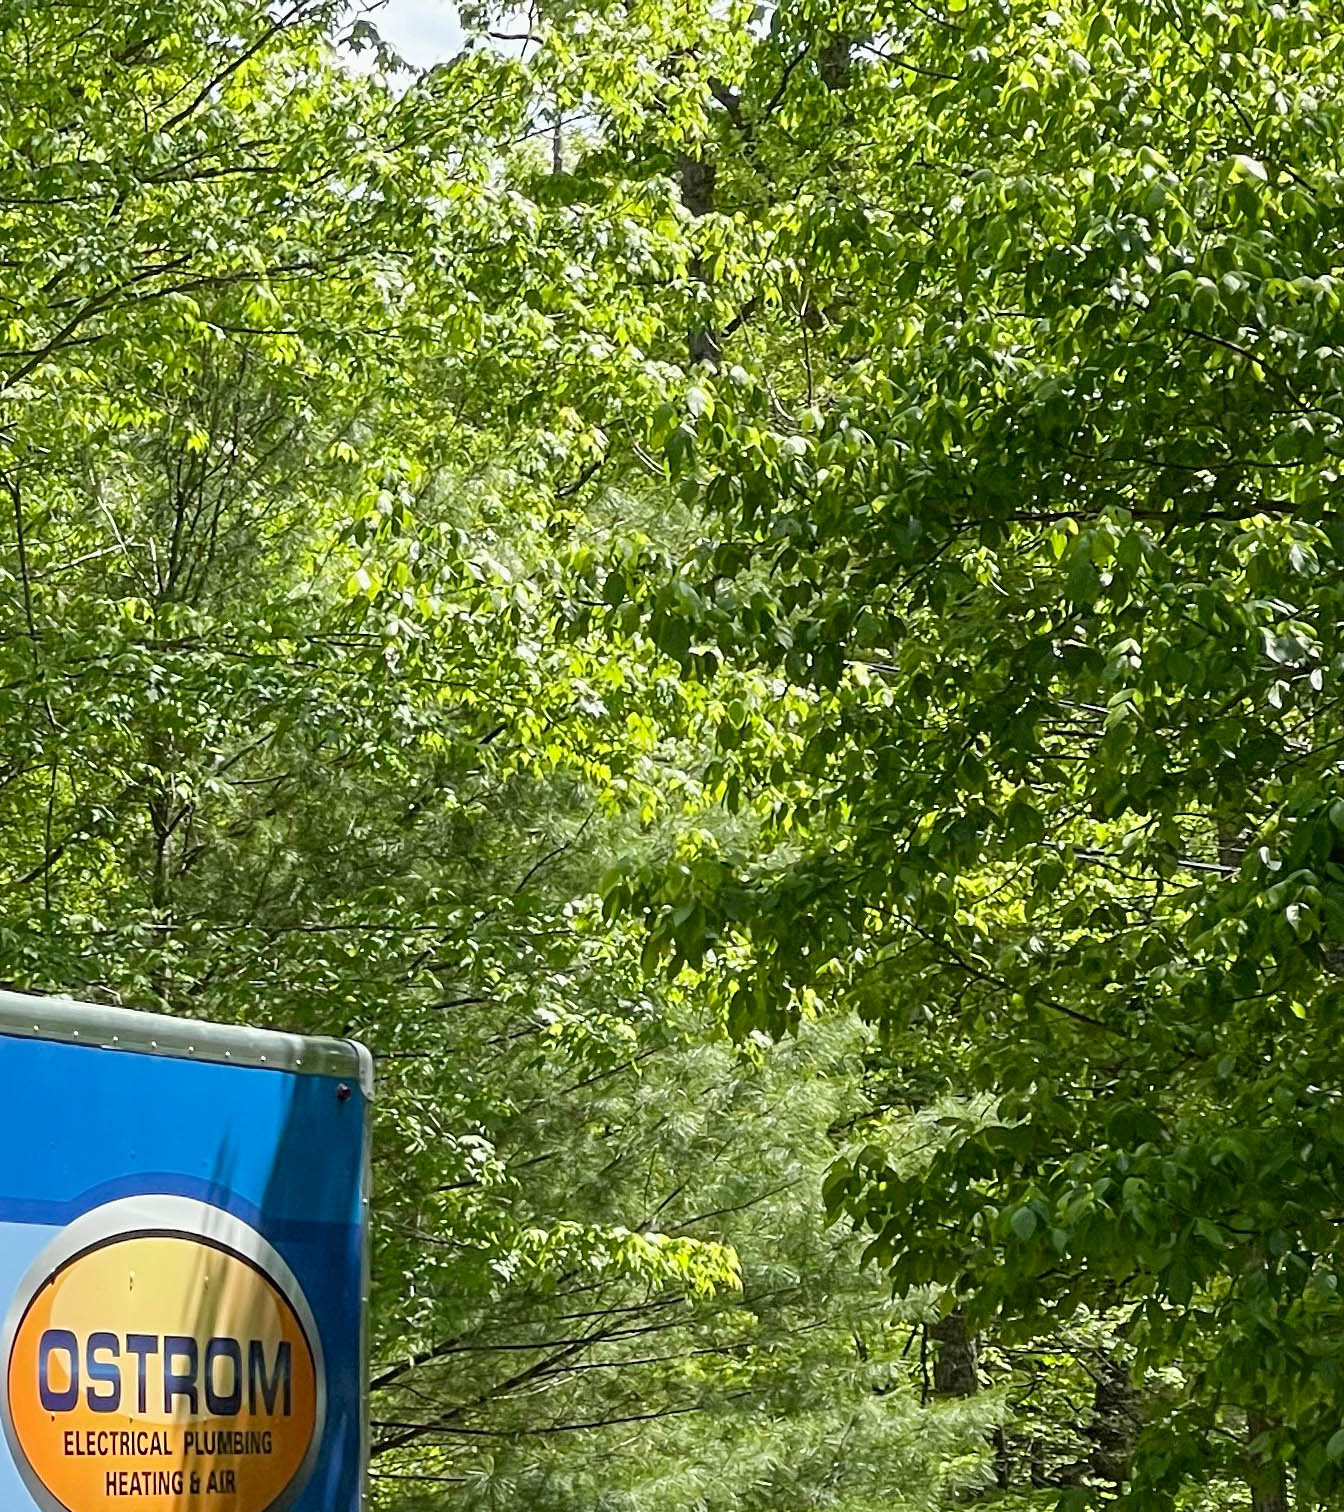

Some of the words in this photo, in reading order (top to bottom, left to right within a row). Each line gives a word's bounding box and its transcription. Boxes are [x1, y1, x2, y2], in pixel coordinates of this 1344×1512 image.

[39, 1329, 291, 1417] OSTROM
[64, 1430, 173, 1456] ELECTRICAL
[184, 1430, 272, 1456] PLUMBING
[106, 1470, 183, 1497] HEATING
[190, 1472, 201, 1495] &
[206, 1470, 237, 1495] AIR
